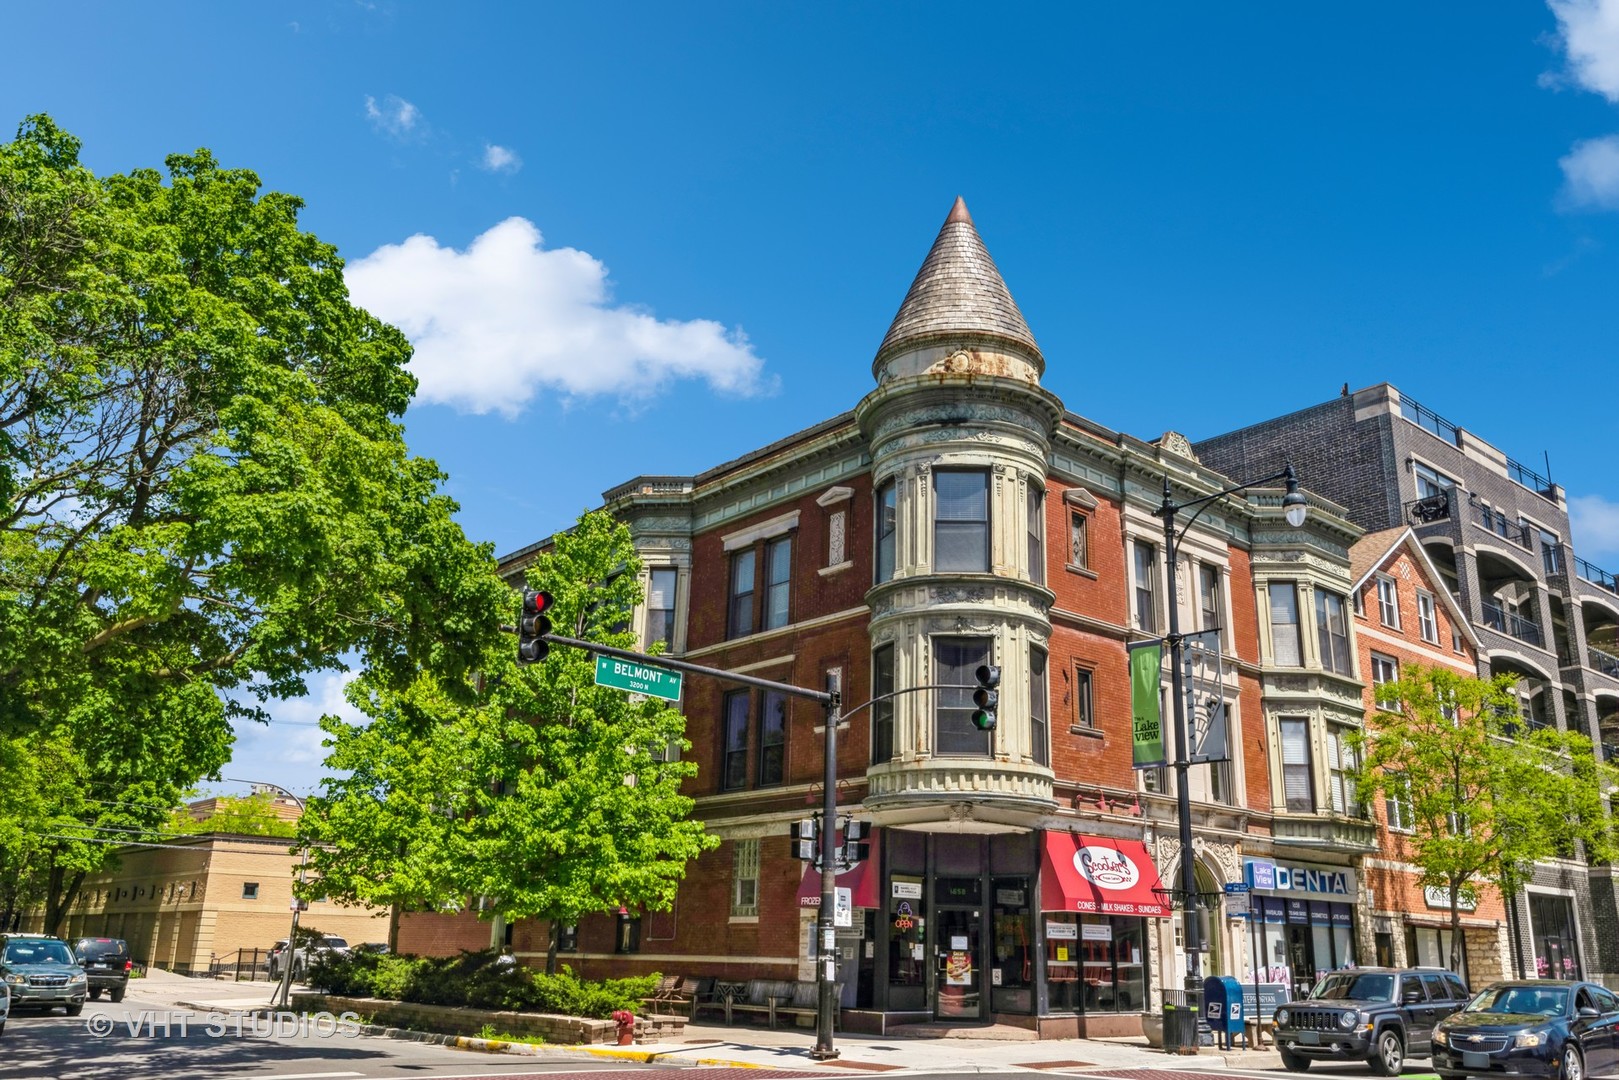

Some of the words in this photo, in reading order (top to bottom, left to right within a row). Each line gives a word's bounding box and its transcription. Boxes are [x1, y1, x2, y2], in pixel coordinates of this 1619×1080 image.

[614, 663, 662, 683] BELMONT
[629, 680, 644, 689] 3200
[1184, 643, 1196, 755] LAKEVIEW
[1134, 720, 1159, 732] Lake
[1135, 730, 1160, 741] view
[1255, 866, 1272, 875] Lake
[1255, 875, 1272, 885] View
[1276, 867, 1357, 894] DENTAL
[1077, 901, 1096, 910] CONES
[1101, 902, 1113, 911] MILK
[1114, 903, 1134, 912] SHAKES
[1138, 905, 1162, 914] SUNDAES
[895, 919, 913, 928] OPEN
